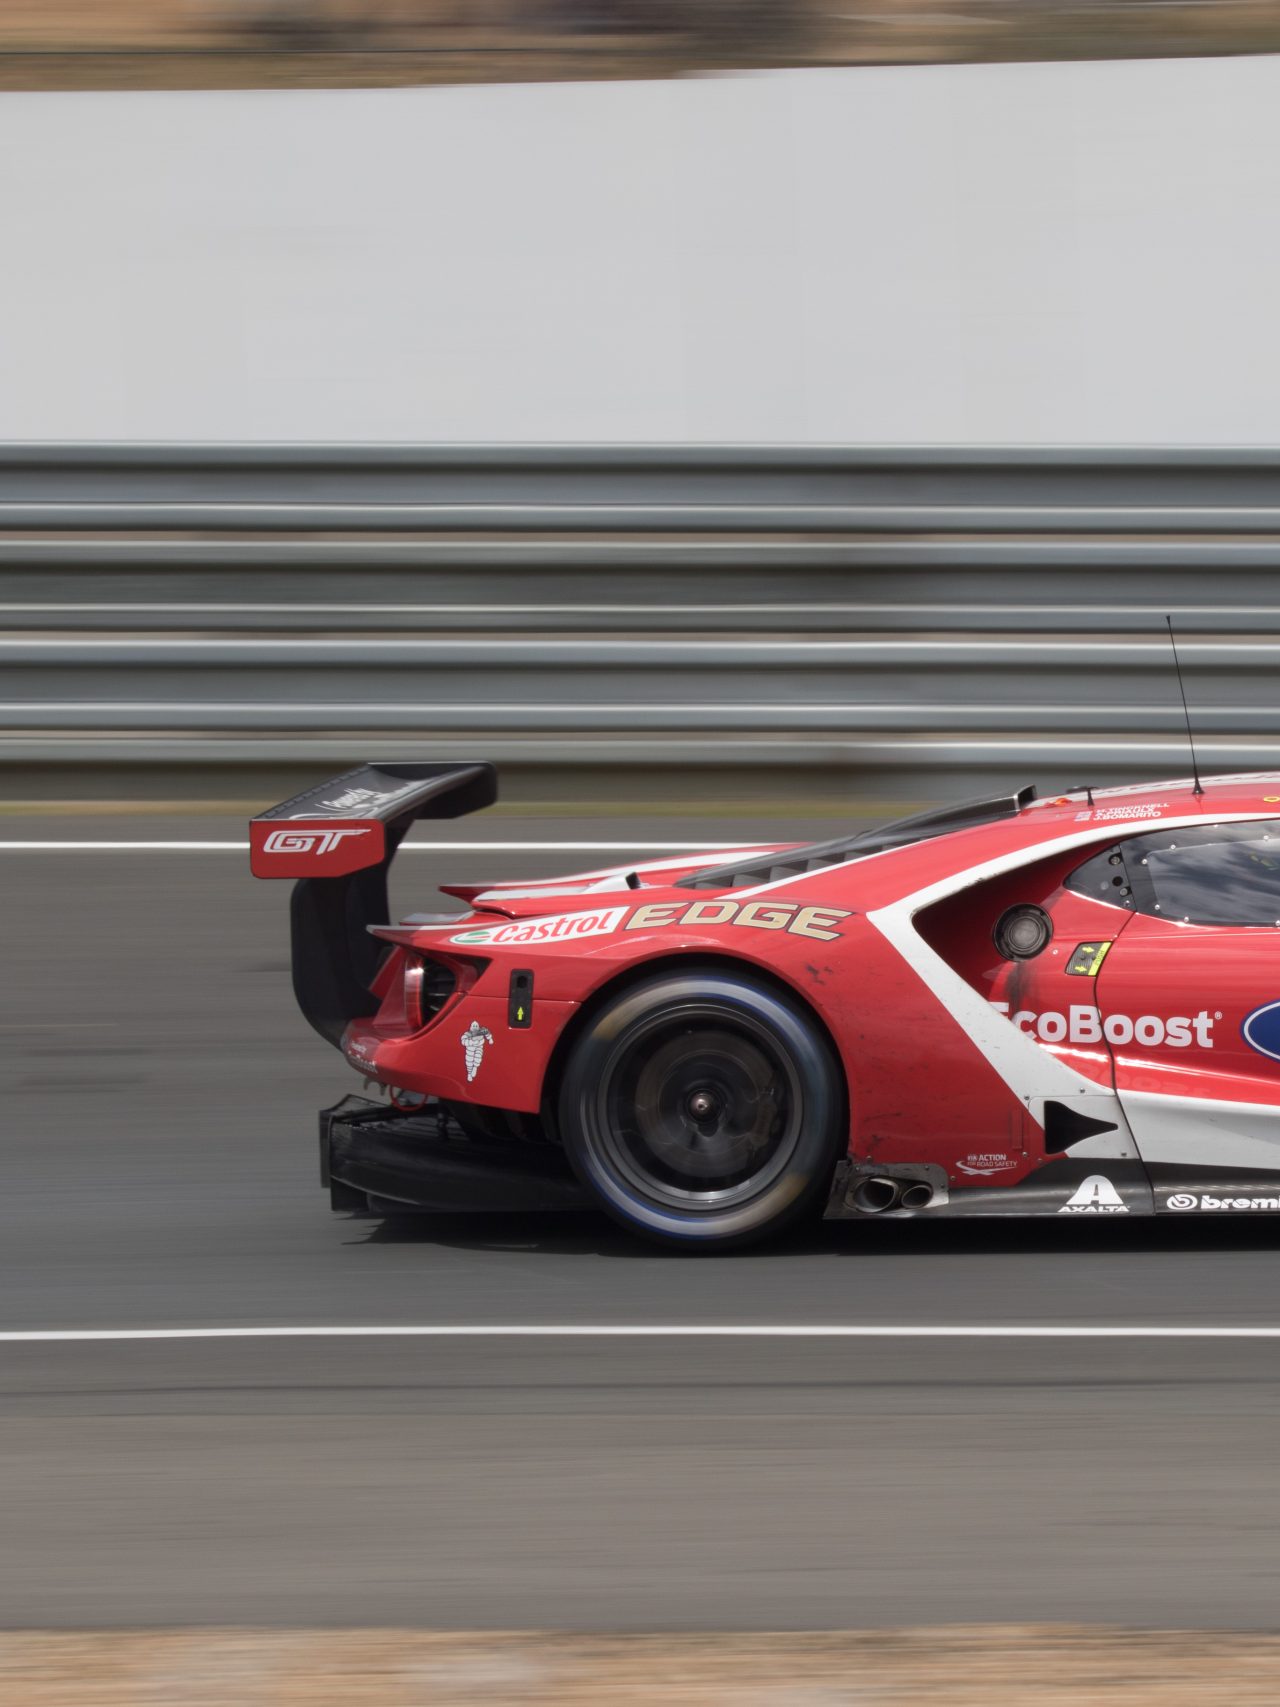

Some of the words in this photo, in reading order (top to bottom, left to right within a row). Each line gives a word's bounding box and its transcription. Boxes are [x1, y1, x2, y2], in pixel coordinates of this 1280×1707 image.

[263, 828, 372, 856] GT
[492, 910, 613, 944] Castrol
[624, 900, 854, 942] EDGE
[1057, 1204, 1130, 1213] AXALTA
